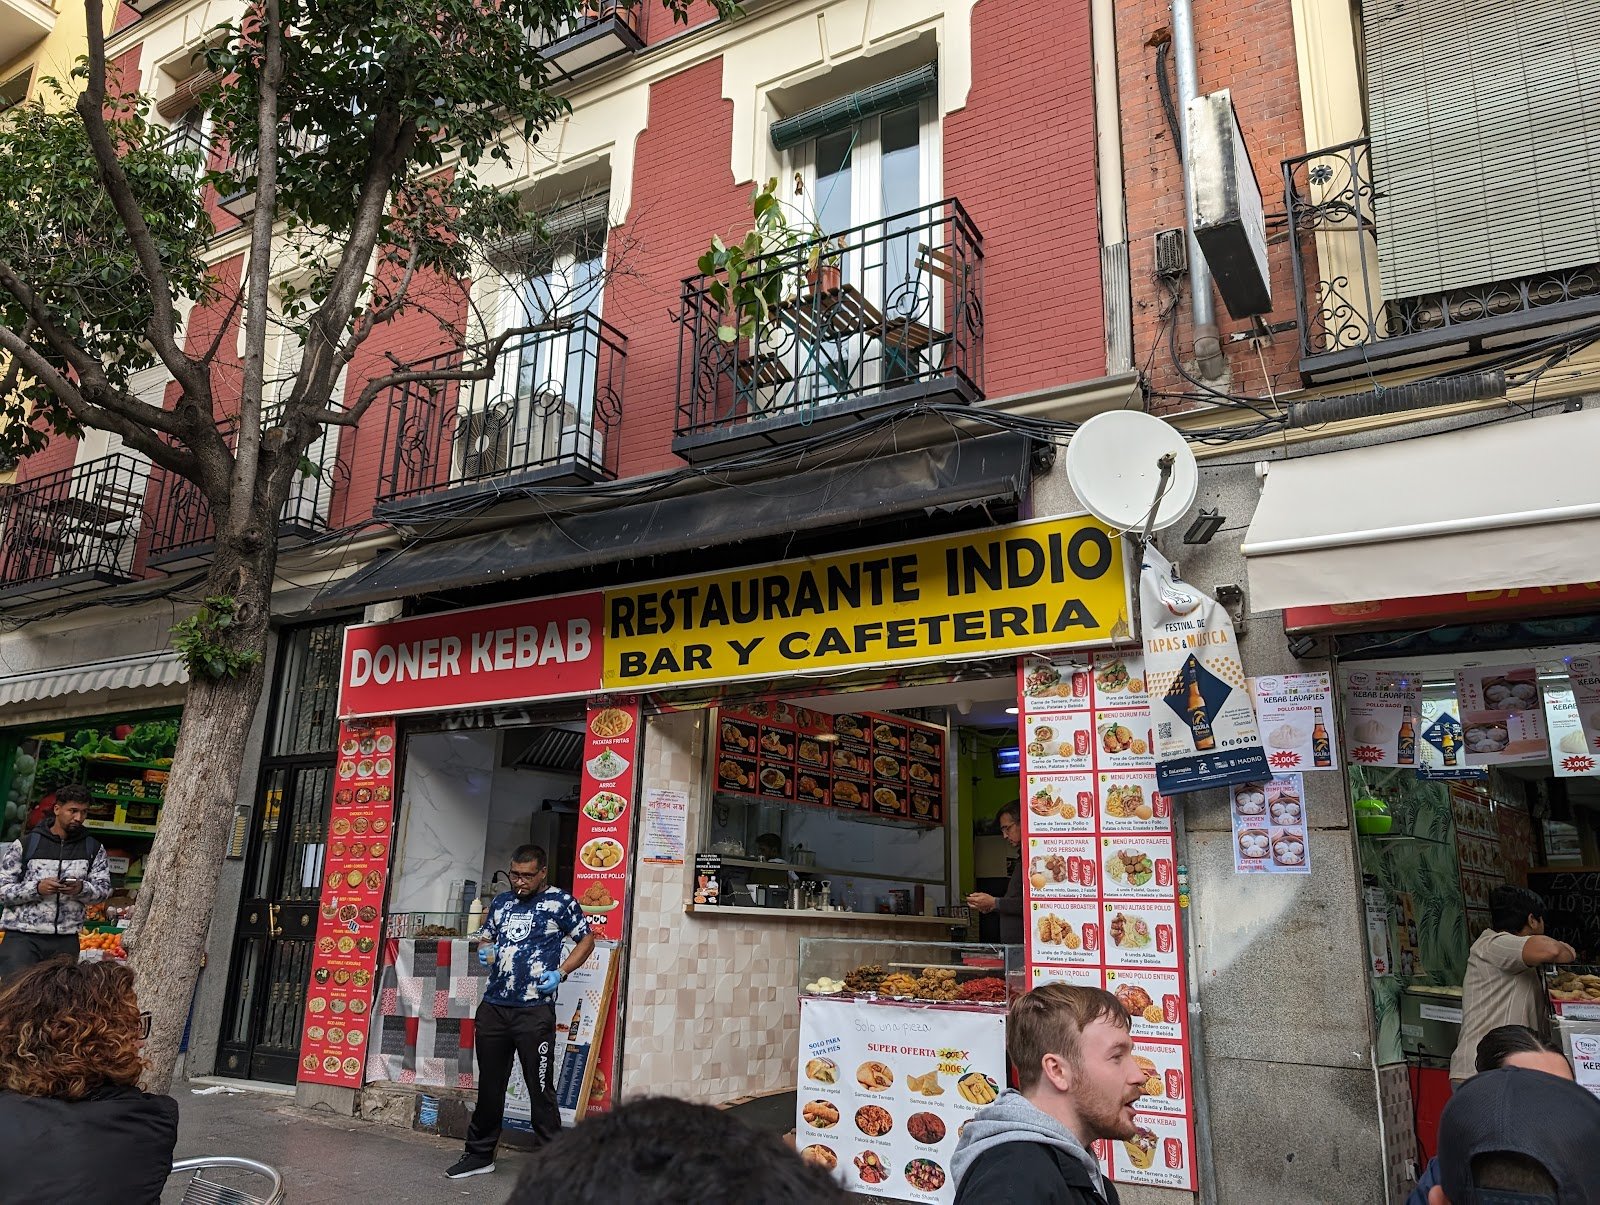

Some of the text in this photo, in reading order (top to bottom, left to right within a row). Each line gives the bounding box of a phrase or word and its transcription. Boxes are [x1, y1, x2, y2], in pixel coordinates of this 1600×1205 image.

[610, 527, 1113, 639] RESTAURANTE INDIO
[1166, 619, 1205, 633] FESTIVAL DE
[620, 598, 1101, 677] BAR Y CAFETERIA
[1147, 637, 1180, 653] TAPAS
[1187, 630, 1228, 648] MÚSICA
[350, 618, 592, 688] DONER KEBAB
[1289, 693, 1325, 702] LAVAPIES
[1380, 692, 1416, 700] LAVAPIES
[1238, 756, 1262, 764] MADRID
[855, 1019, 876, 1033] Solo
[881, 1023, 901, 1032] una
[808, 1037, 841, 1049] SOLO PARA
[812, 1044, 841, 1057] TAPA PIÉS
[868, 1043, 936, 1058] SUPER OFERTA
[938, 1064, 962, 1073] 2.00€
[803, 1085, 820, 1093] Samosa
[934, 1100, 945, 1108] Pollo
[875, 1139, 891, 1147] Patatas
